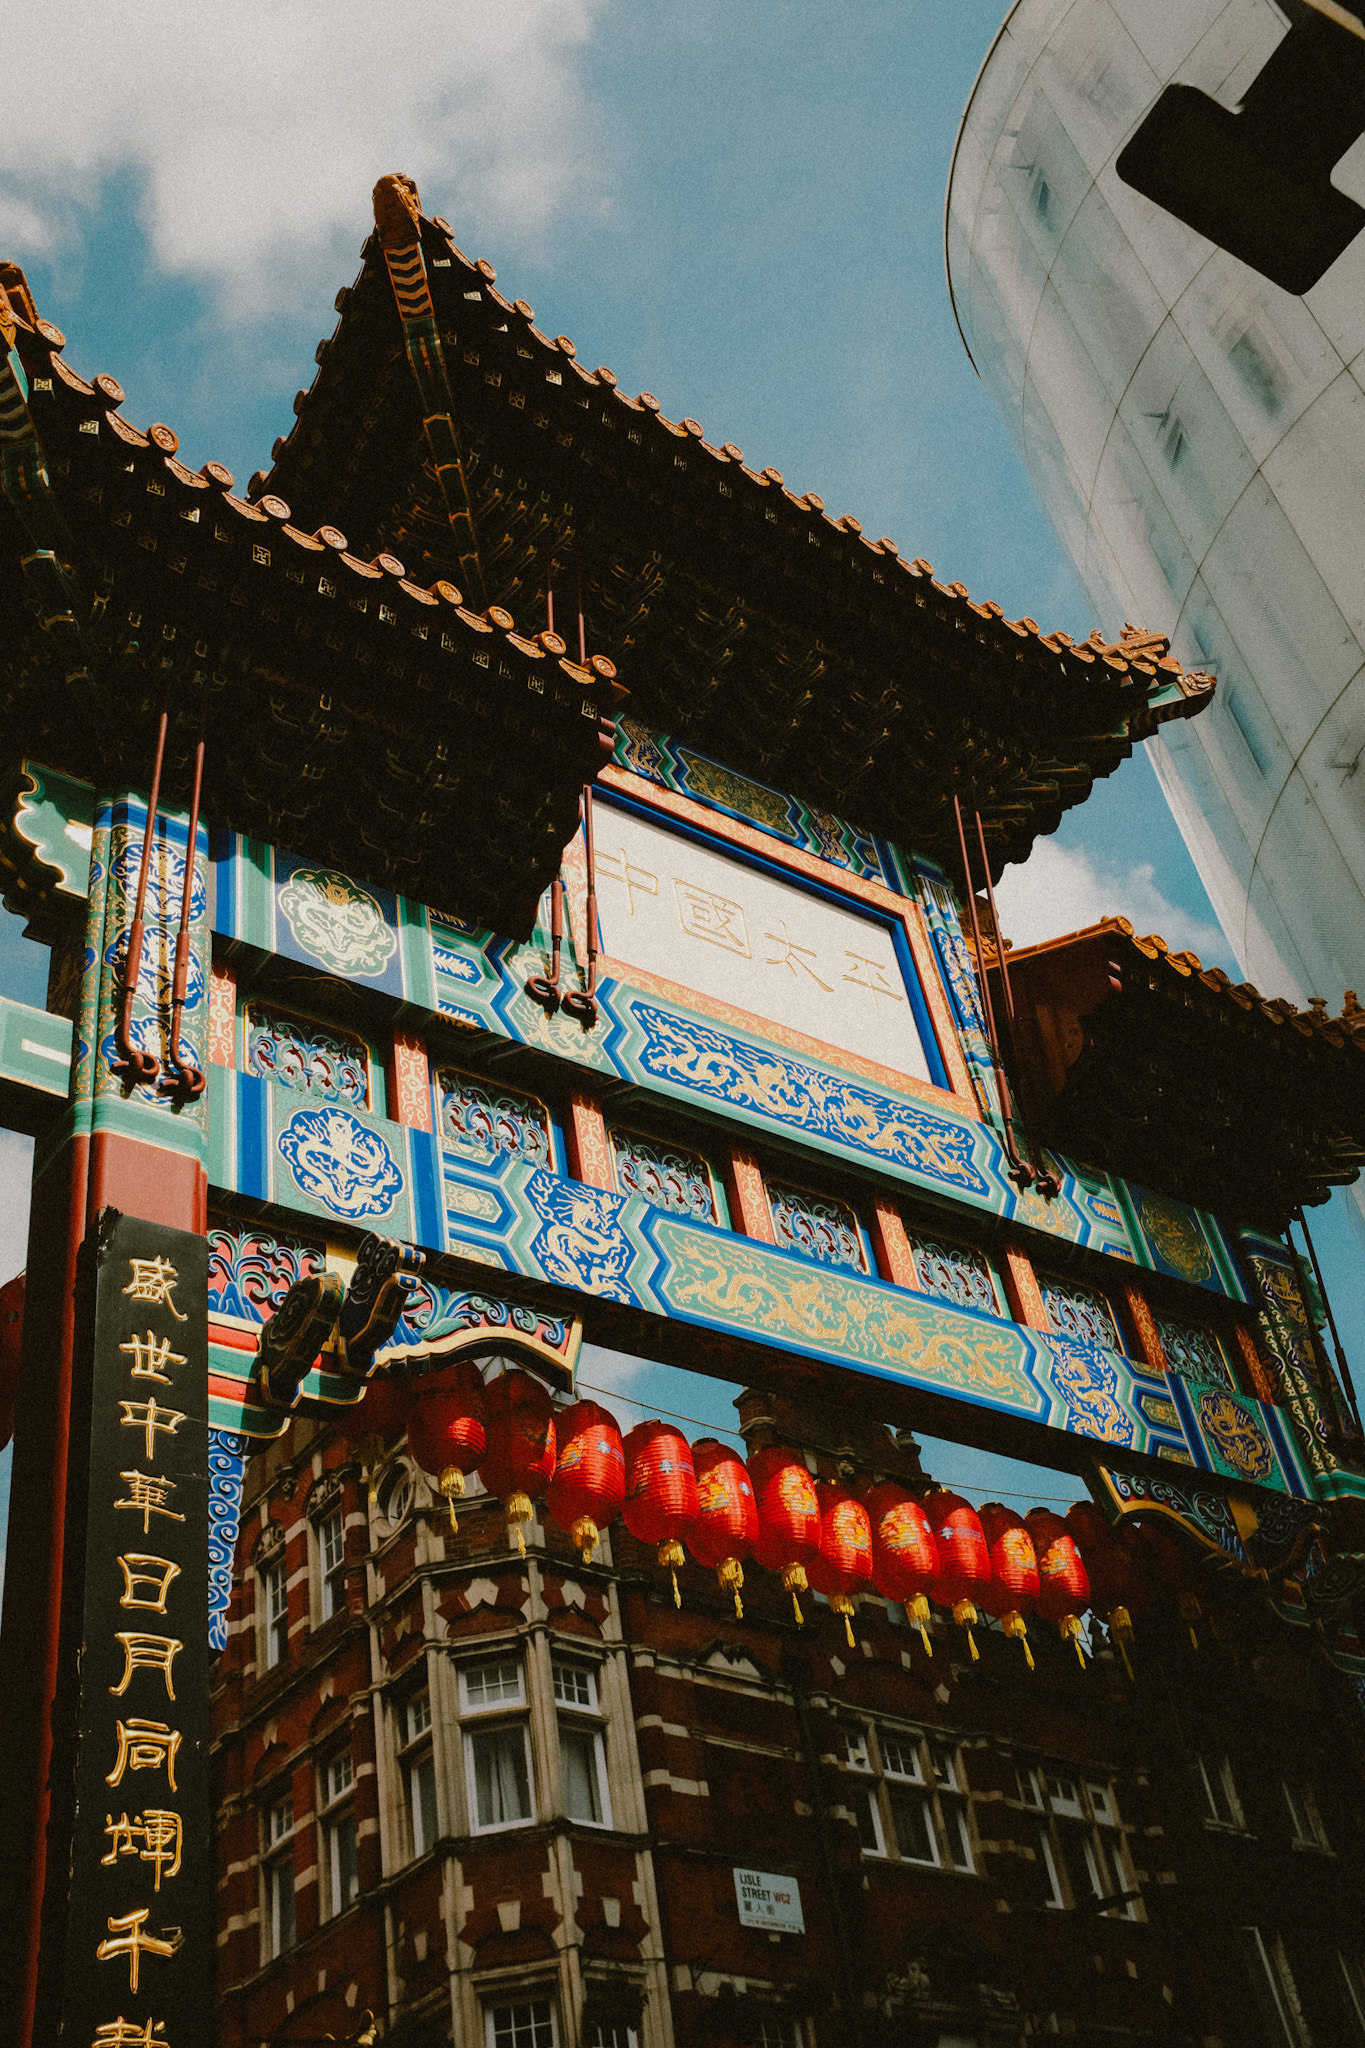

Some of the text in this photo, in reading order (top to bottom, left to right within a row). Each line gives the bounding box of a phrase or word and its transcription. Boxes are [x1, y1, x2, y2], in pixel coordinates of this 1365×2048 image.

[740, 1873, 761, 1886] LISLE
[741, 1886, 791, 1905] STREET WC2
